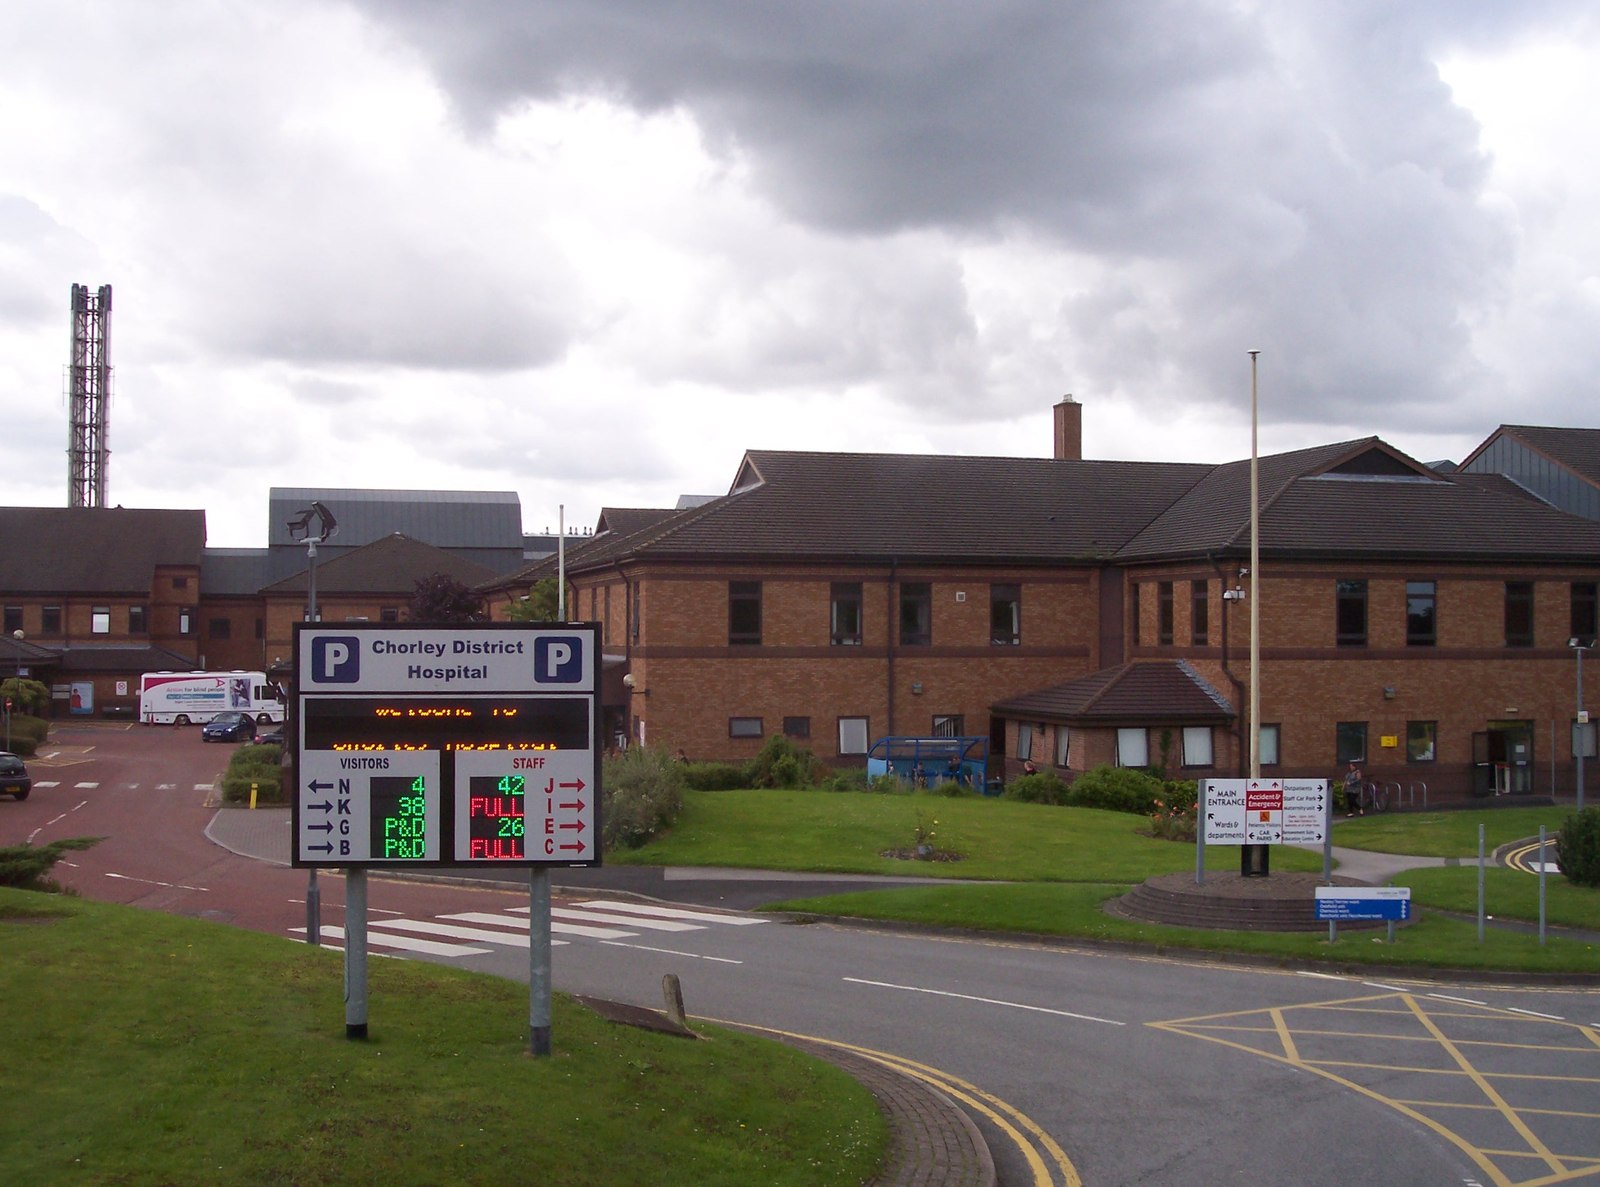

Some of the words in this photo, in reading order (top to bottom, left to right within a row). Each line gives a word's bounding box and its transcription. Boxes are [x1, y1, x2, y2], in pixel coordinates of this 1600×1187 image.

[372, 640, 446, 657] Chorley
[453, 640, 523, 654] District
[325, 643, 349, 677] P
[547, 643, 572, 677] P
[408, 665, 487, 682] Hospital
[340, 757, 389, 769] VISITORS
[513, 757, 545, 769] STAFF
[338, 778, 350, 794] N
[411, 776, 425, 795] 4
[498, 776, 525, 795] 42
[544, 778, 554, 794] J
[338, 799, 351, 815] K
[399, 797, 425, 816] 38
[471, 798, 525, 817] FULL
[547, 798, 552, 813] I
[340, 819, 350, 835] G
[385, 818, 425, 837] P&D
[498, 818, 525, 837] 26
[545, 818, 554, 834] E
[1208, 832, 1244, 841] departments
[340, 840, 351, 855] B
[385, 839, 425, 858] P&D
[471, 839, 525, 858] FULL
[545, 838, 554, 854] C
